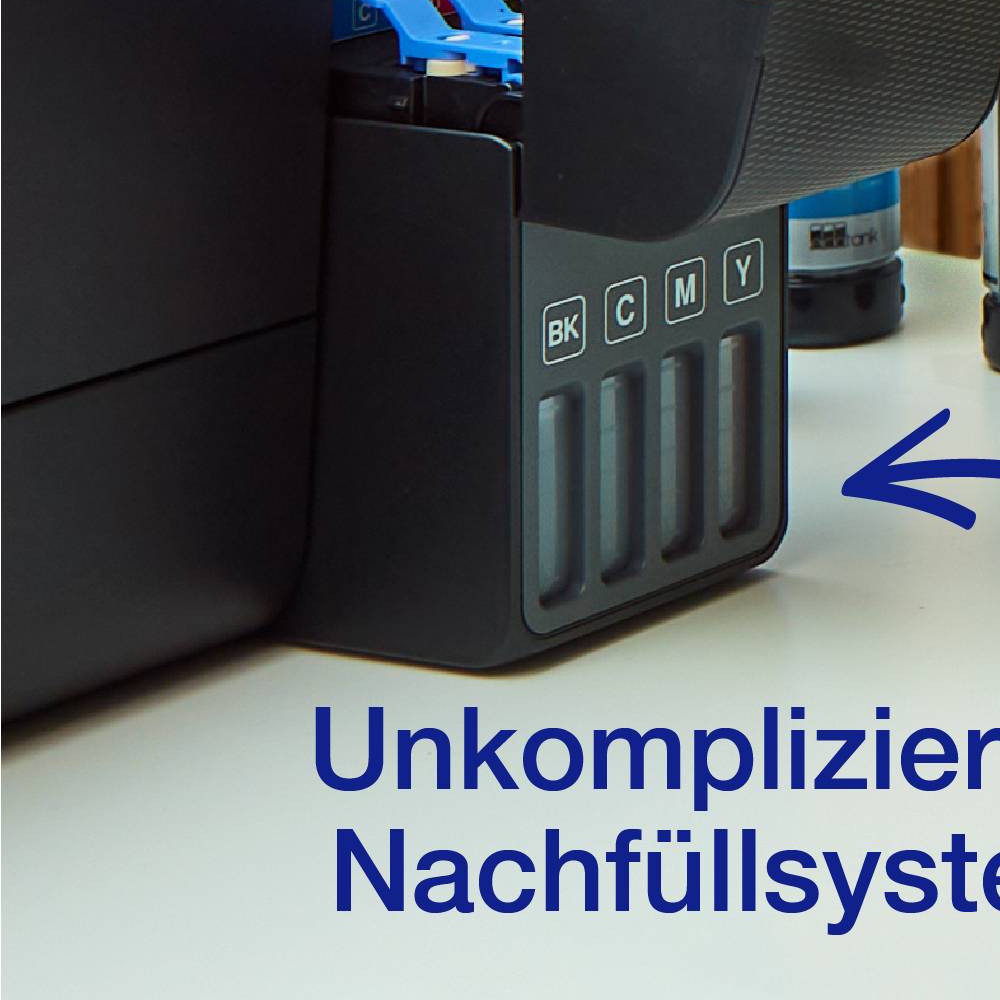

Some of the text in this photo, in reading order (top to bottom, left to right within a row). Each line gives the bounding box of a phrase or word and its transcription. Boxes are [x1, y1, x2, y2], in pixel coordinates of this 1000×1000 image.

[548, 254, 752, 348] BK C M Y
